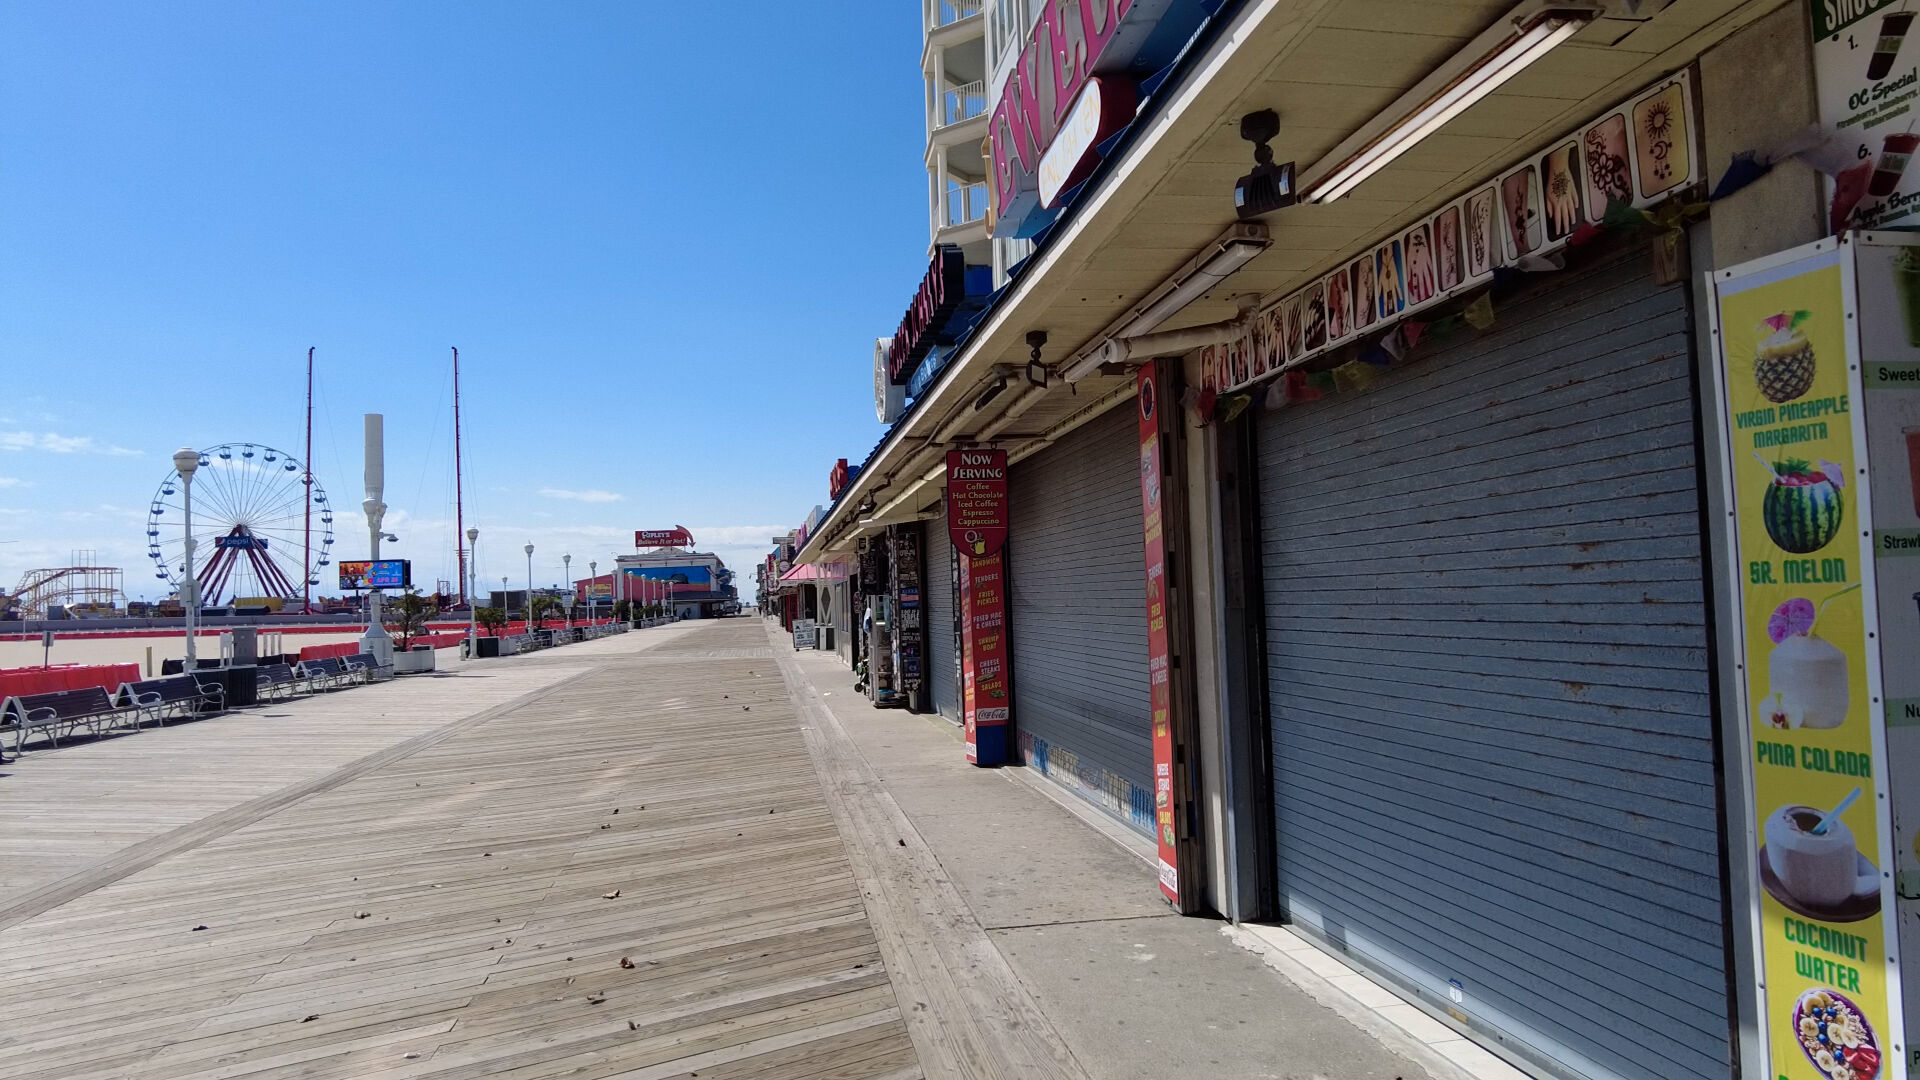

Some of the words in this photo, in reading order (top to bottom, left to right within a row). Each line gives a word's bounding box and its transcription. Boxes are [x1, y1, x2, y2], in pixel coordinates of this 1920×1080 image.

[1824, 0, 1880, 31] SMO
[1847, 34, 1858, 50] 1.
[1848, 88, 1869, 110] OC
[1871, 66, 1917, 100] Special
[1858, 143, 1872, 159] 6.
[1735, 407, 1775, 429] VIRGIN
[1779, 394, 1849, 422] PINEAPPLE
[1753, 422, 1828, 448] MARGARITA
[966, 483, 990, 491] Coffee
[952, 492, 966, 500] Hot
[968, 491, 1004, 499] Chocolate
[958, 500, 973, 508] Iced
[975, 500, 999, 508] Coffee
[962, 509, 994, 518] Espresso
[957, 518, 1000, 527] Cappuccino
[971, 557, 1000, 568] SANDWICH
[975, 573, 999, 584] TENDERS
[1749, 560, 1778, 585] SR.
[1783, 558, 1847, 585] MELON
[1757, 740, 1797, 769] PINA
[1801, 745, 1871, 778] COLADA
[1783, 916, 1869, 962] COCONUT
[1794, 950, 1862, 995] WATER
